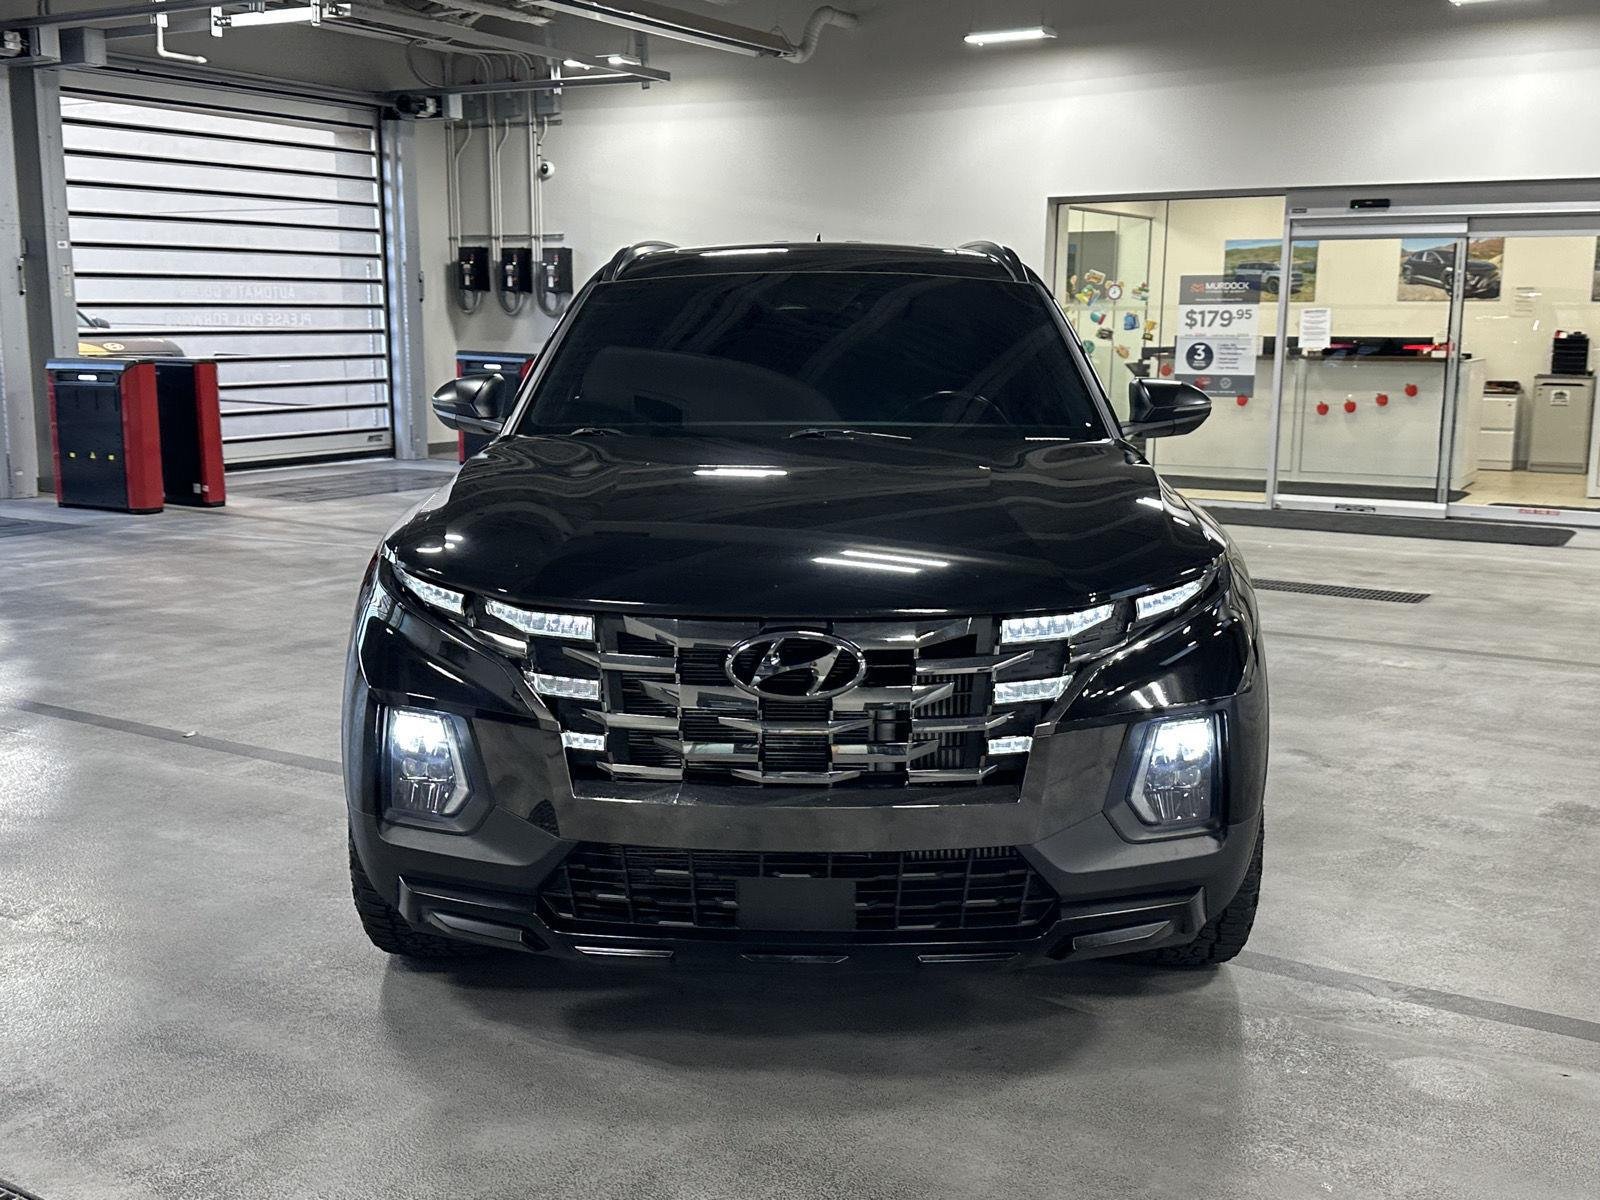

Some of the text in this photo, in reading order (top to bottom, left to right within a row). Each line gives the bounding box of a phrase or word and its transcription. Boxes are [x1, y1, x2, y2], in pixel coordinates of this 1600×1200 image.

[1205, 281, 1250, 290] MURDOCK
[1185, 309, 1252, 329] $179.95
[1194, 344, 1206, 360] 3
